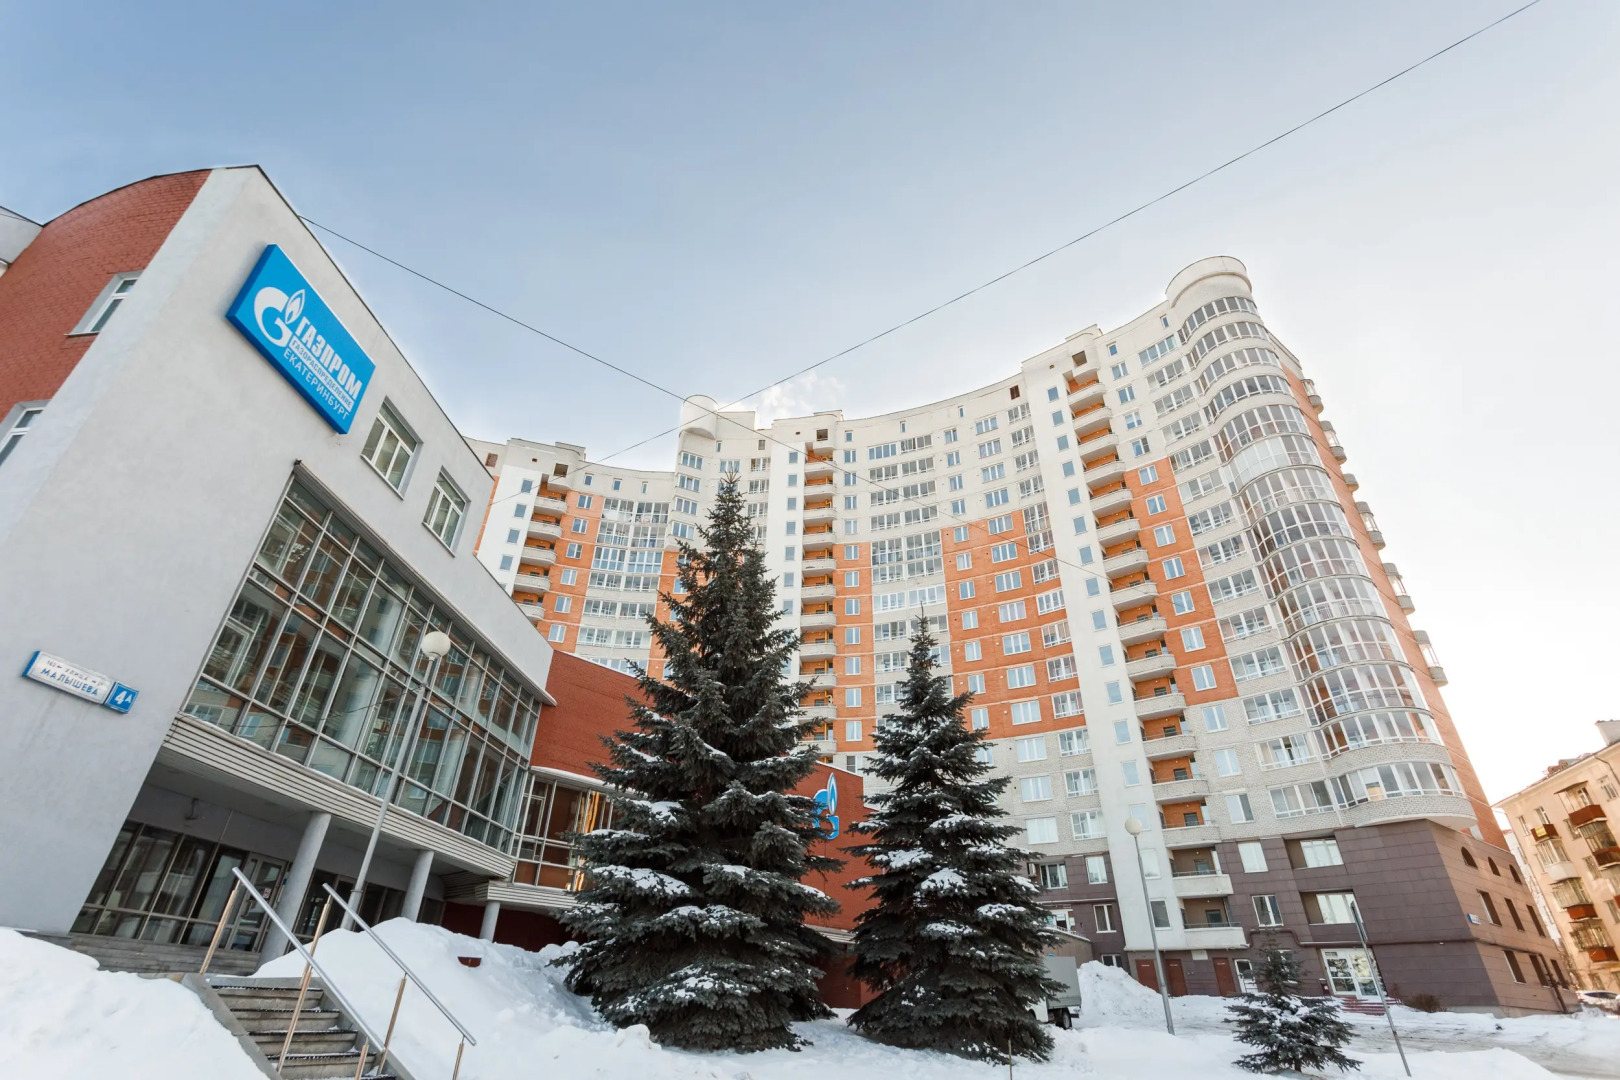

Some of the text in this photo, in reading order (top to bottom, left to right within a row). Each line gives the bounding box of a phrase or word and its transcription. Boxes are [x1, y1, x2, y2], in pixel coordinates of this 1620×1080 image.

[290, 338, 354, 409] ГАЗОРАСПРЕДЕЛЕНИЕ
[294, 316, 363, 400] ГАЗПРОМ
[283, 350, 350, 421] ЕКАТЕРИНБУРГ
[40, 667, 98, 696] МАЛЫШЕВА
[65, 667, 89, 681] УЛИЦА
[114, 690, 133, 705] 4А
